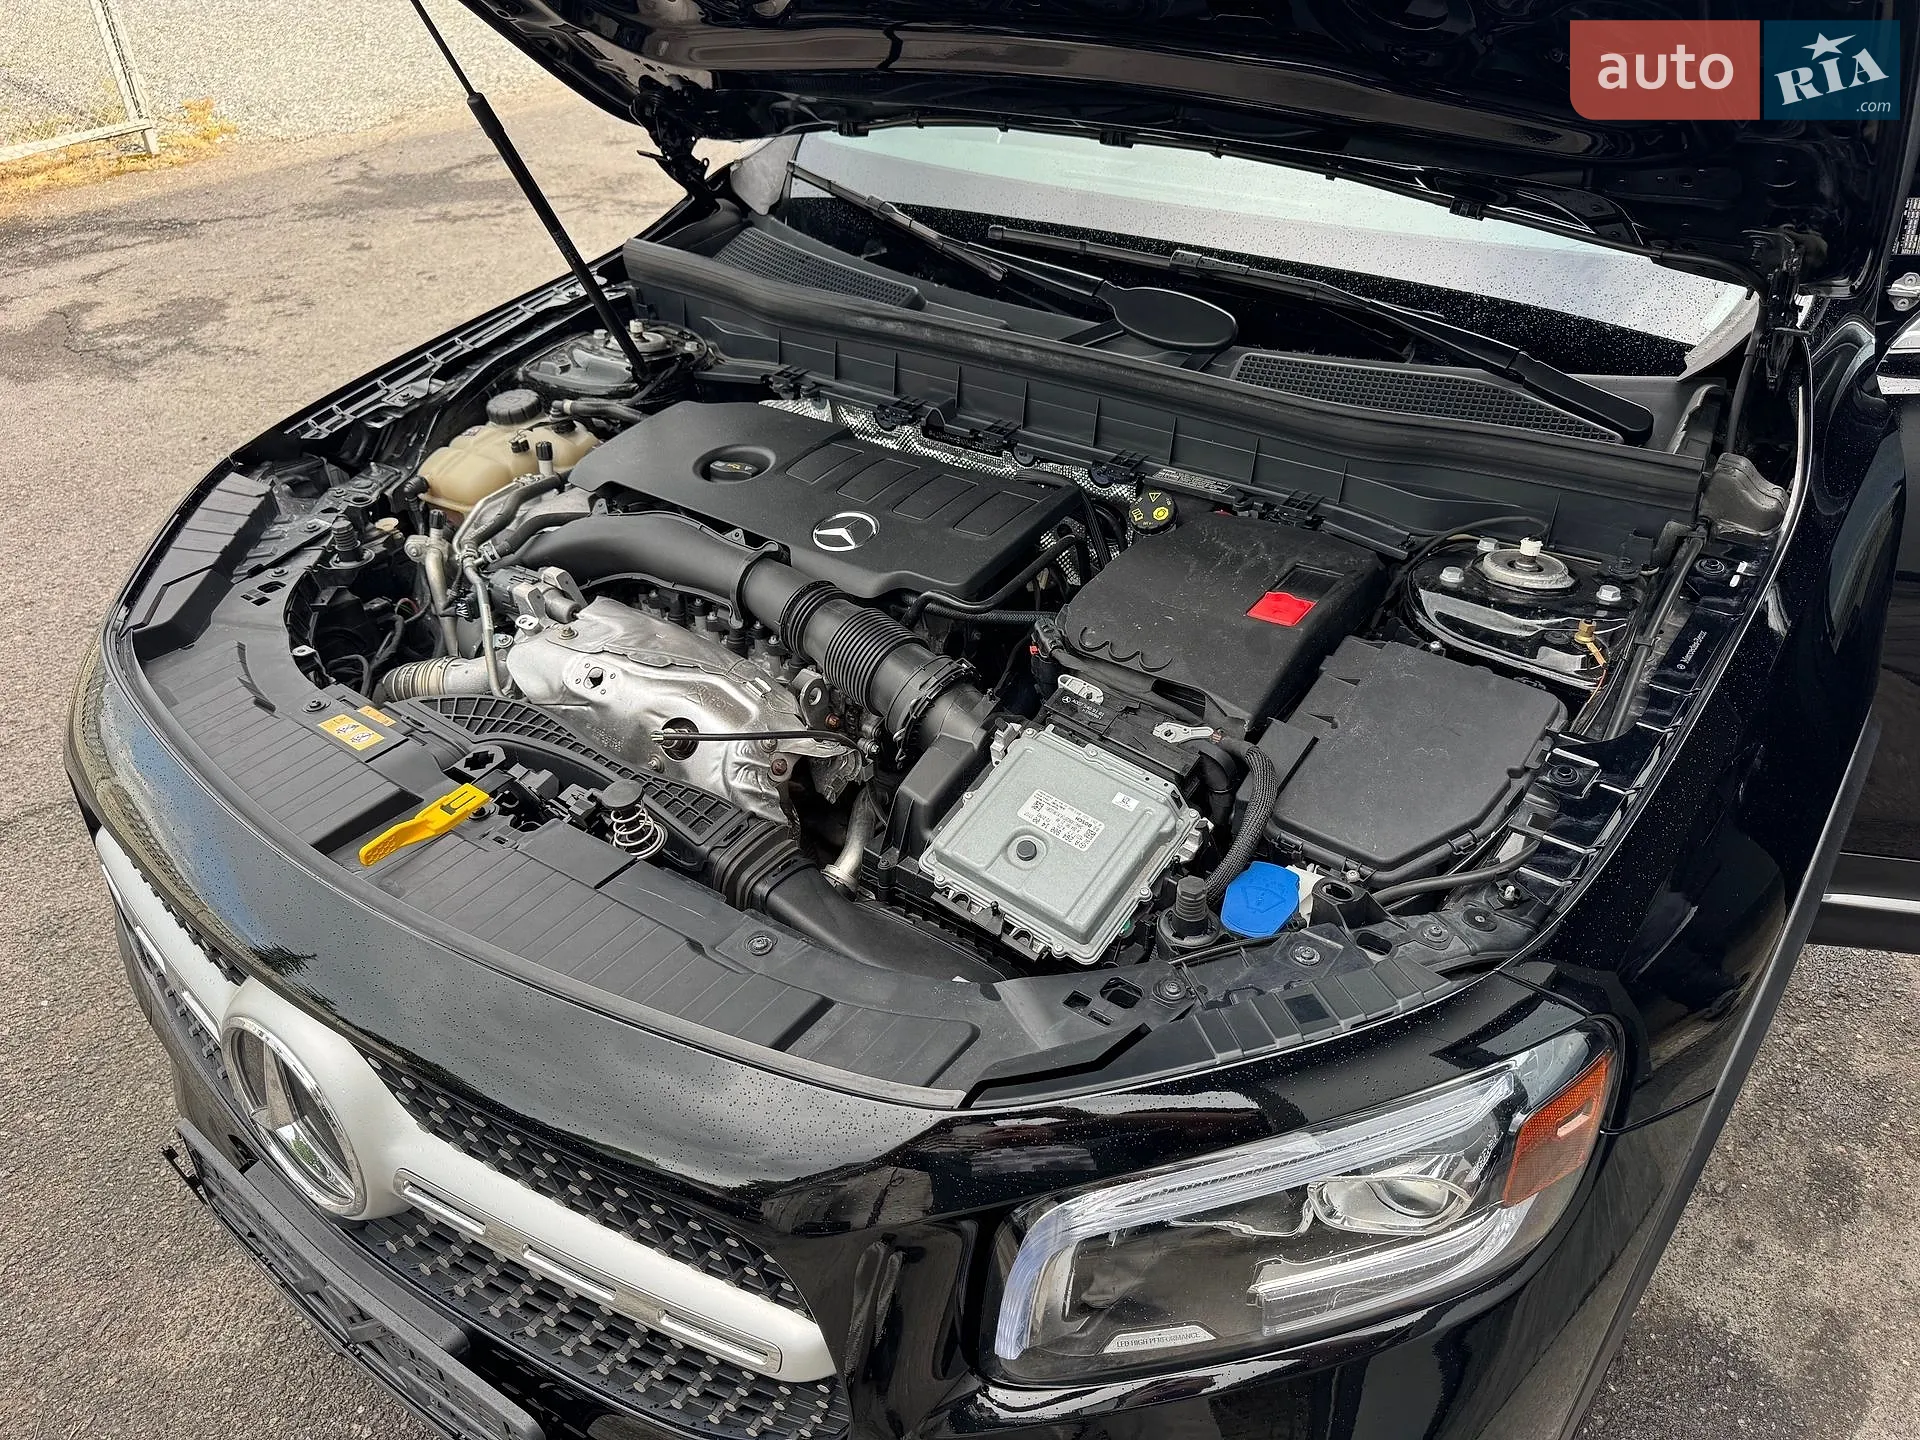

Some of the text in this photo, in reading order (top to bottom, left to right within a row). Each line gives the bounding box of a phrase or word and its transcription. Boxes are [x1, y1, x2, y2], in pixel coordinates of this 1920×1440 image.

[1074, 816, 1093, 828] BOSCH
[1116, 1332, 1200, 1348] LED HIGH PERFORMANCE
